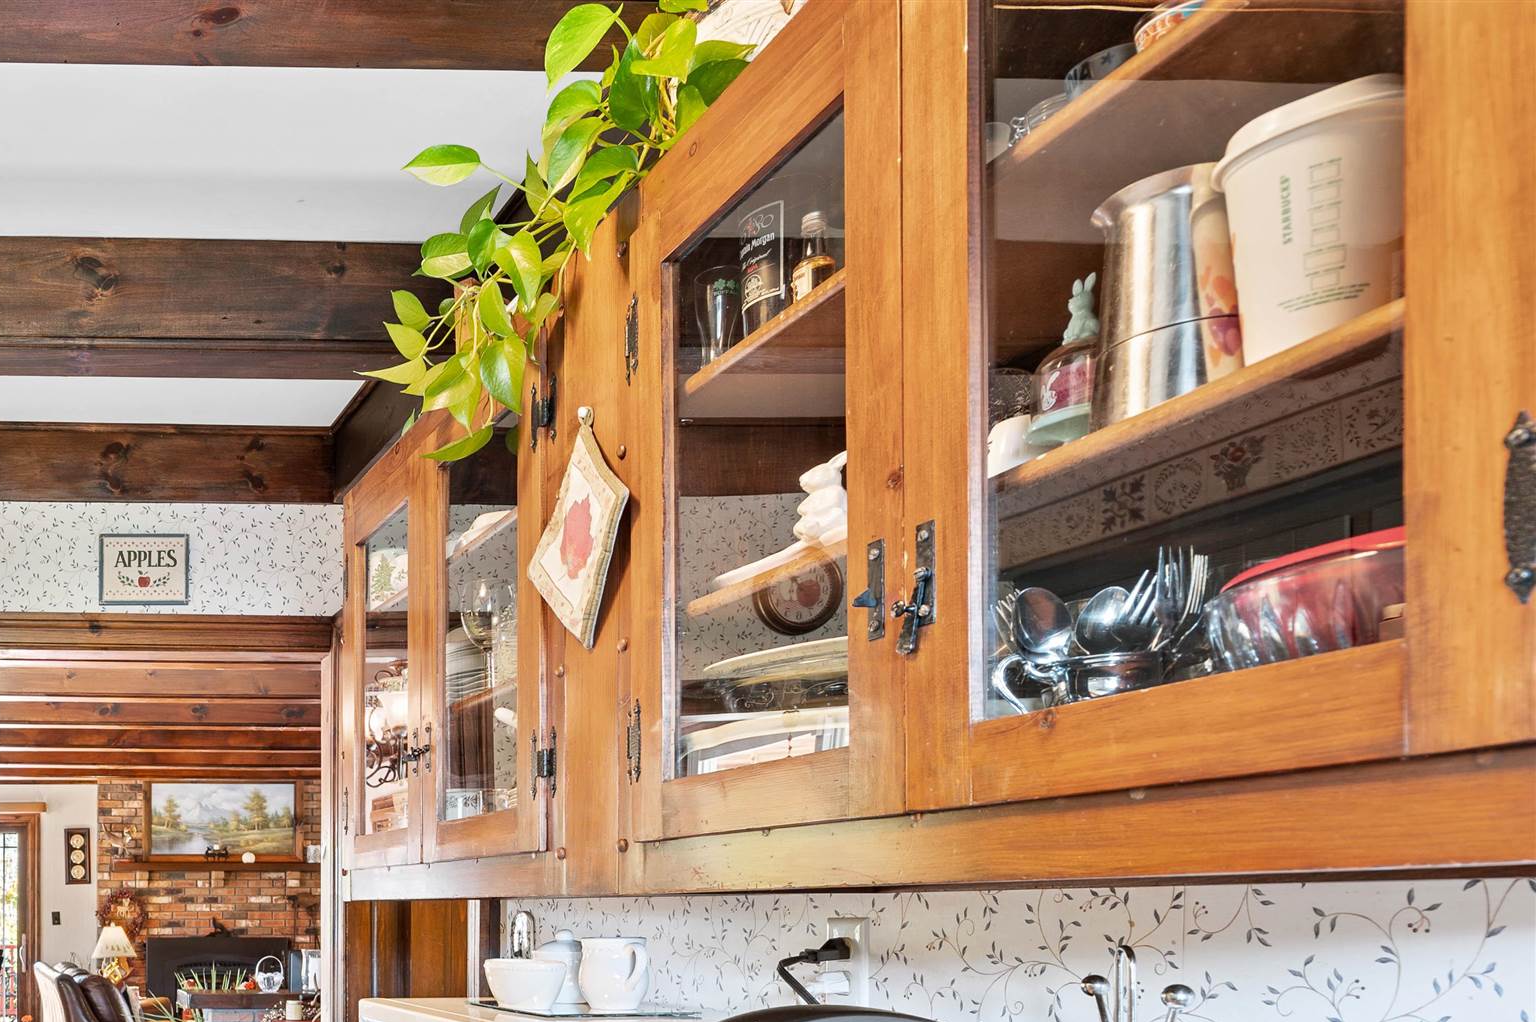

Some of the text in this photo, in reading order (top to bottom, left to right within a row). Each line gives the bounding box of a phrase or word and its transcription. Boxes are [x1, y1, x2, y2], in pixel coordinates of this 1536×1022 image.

[1279, 175, 1293, 246] STARBUCKS
[751, 232, 775, 250] Morgan
[114, 549, 178, 568] APPLES
